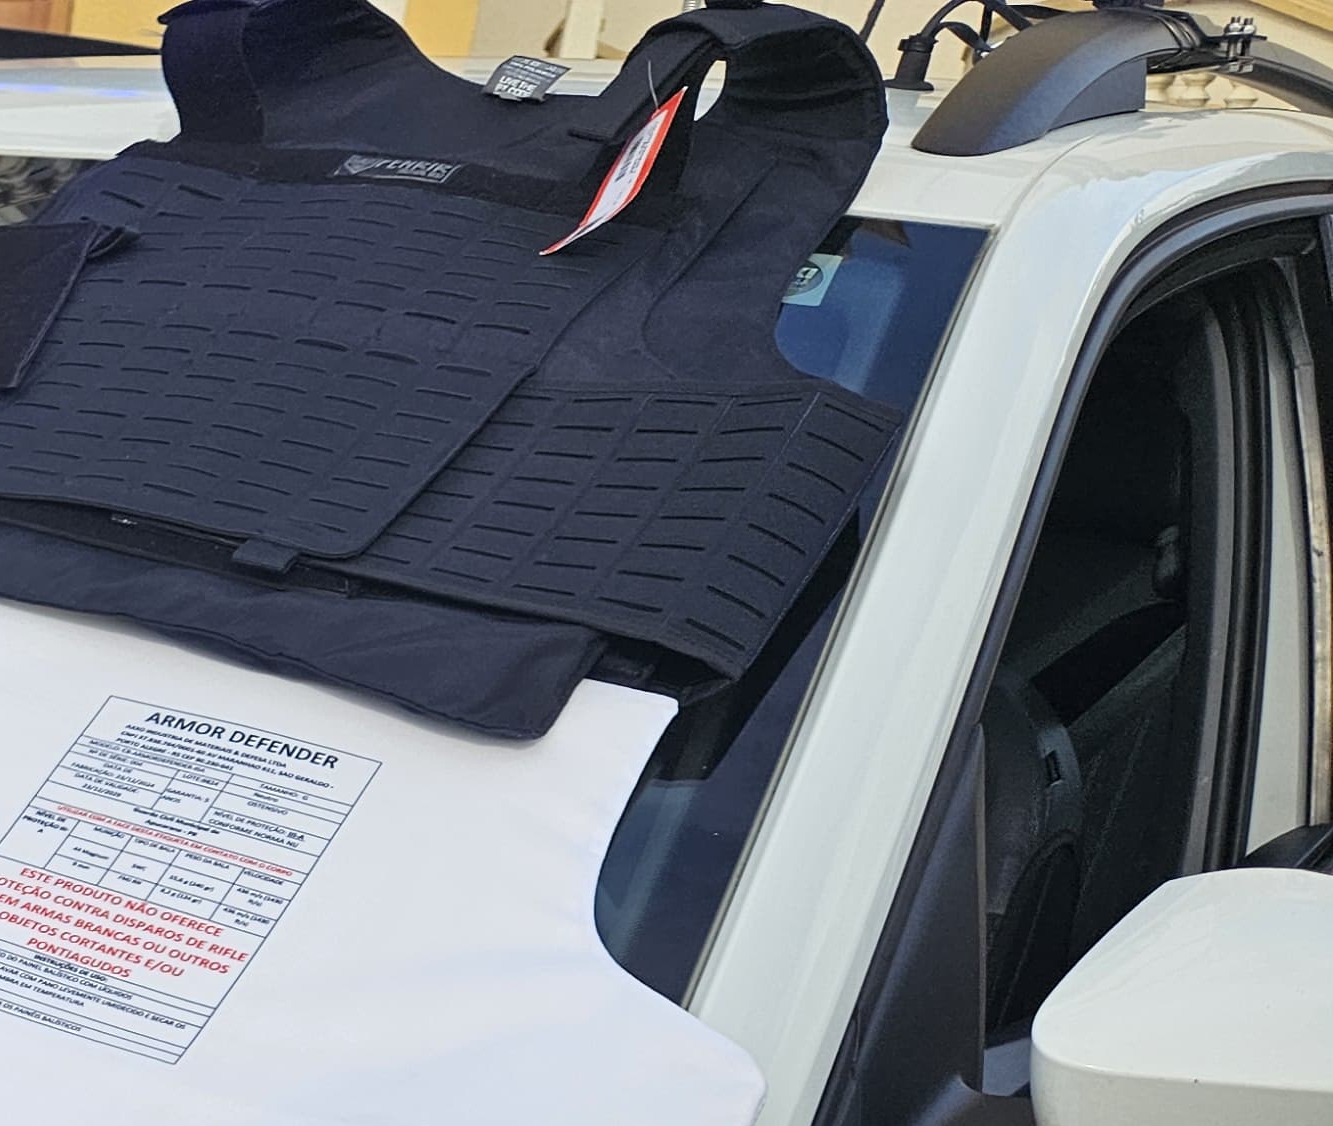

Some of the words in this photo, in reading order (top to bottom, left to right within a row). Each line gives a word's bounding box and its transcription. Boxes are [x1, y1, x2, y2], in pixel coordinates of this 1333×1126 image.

[144, 712, 225, 739] ARMOR
[228, 730, 338, 768] DEFENDER
[19, 867, 53, 883] ESTE
[52, 878, 122, 905] PRODUTO
[123, 898, 162, 916] NÃO
[159, 911, 223, 936] OFERECE
[52, 895, 109, 919] CONTRA
[112, 913, 184, 942] DISPAROS
[185, 936, 207, 949] DE
[207, 943, 248, 961] RIFLE
[19, 902, 72, 923] ARMAS
[73, 918, 141, 945] BRANCAS
[142, 941, 166, 953] OU
[168, 948, 229, 973] OUTROS
[22, 937, 131, 977] PONTIAGUDOS
[59, 931, 142, 964] CORTANTES
[143, 958, 184, 976] E/OU
